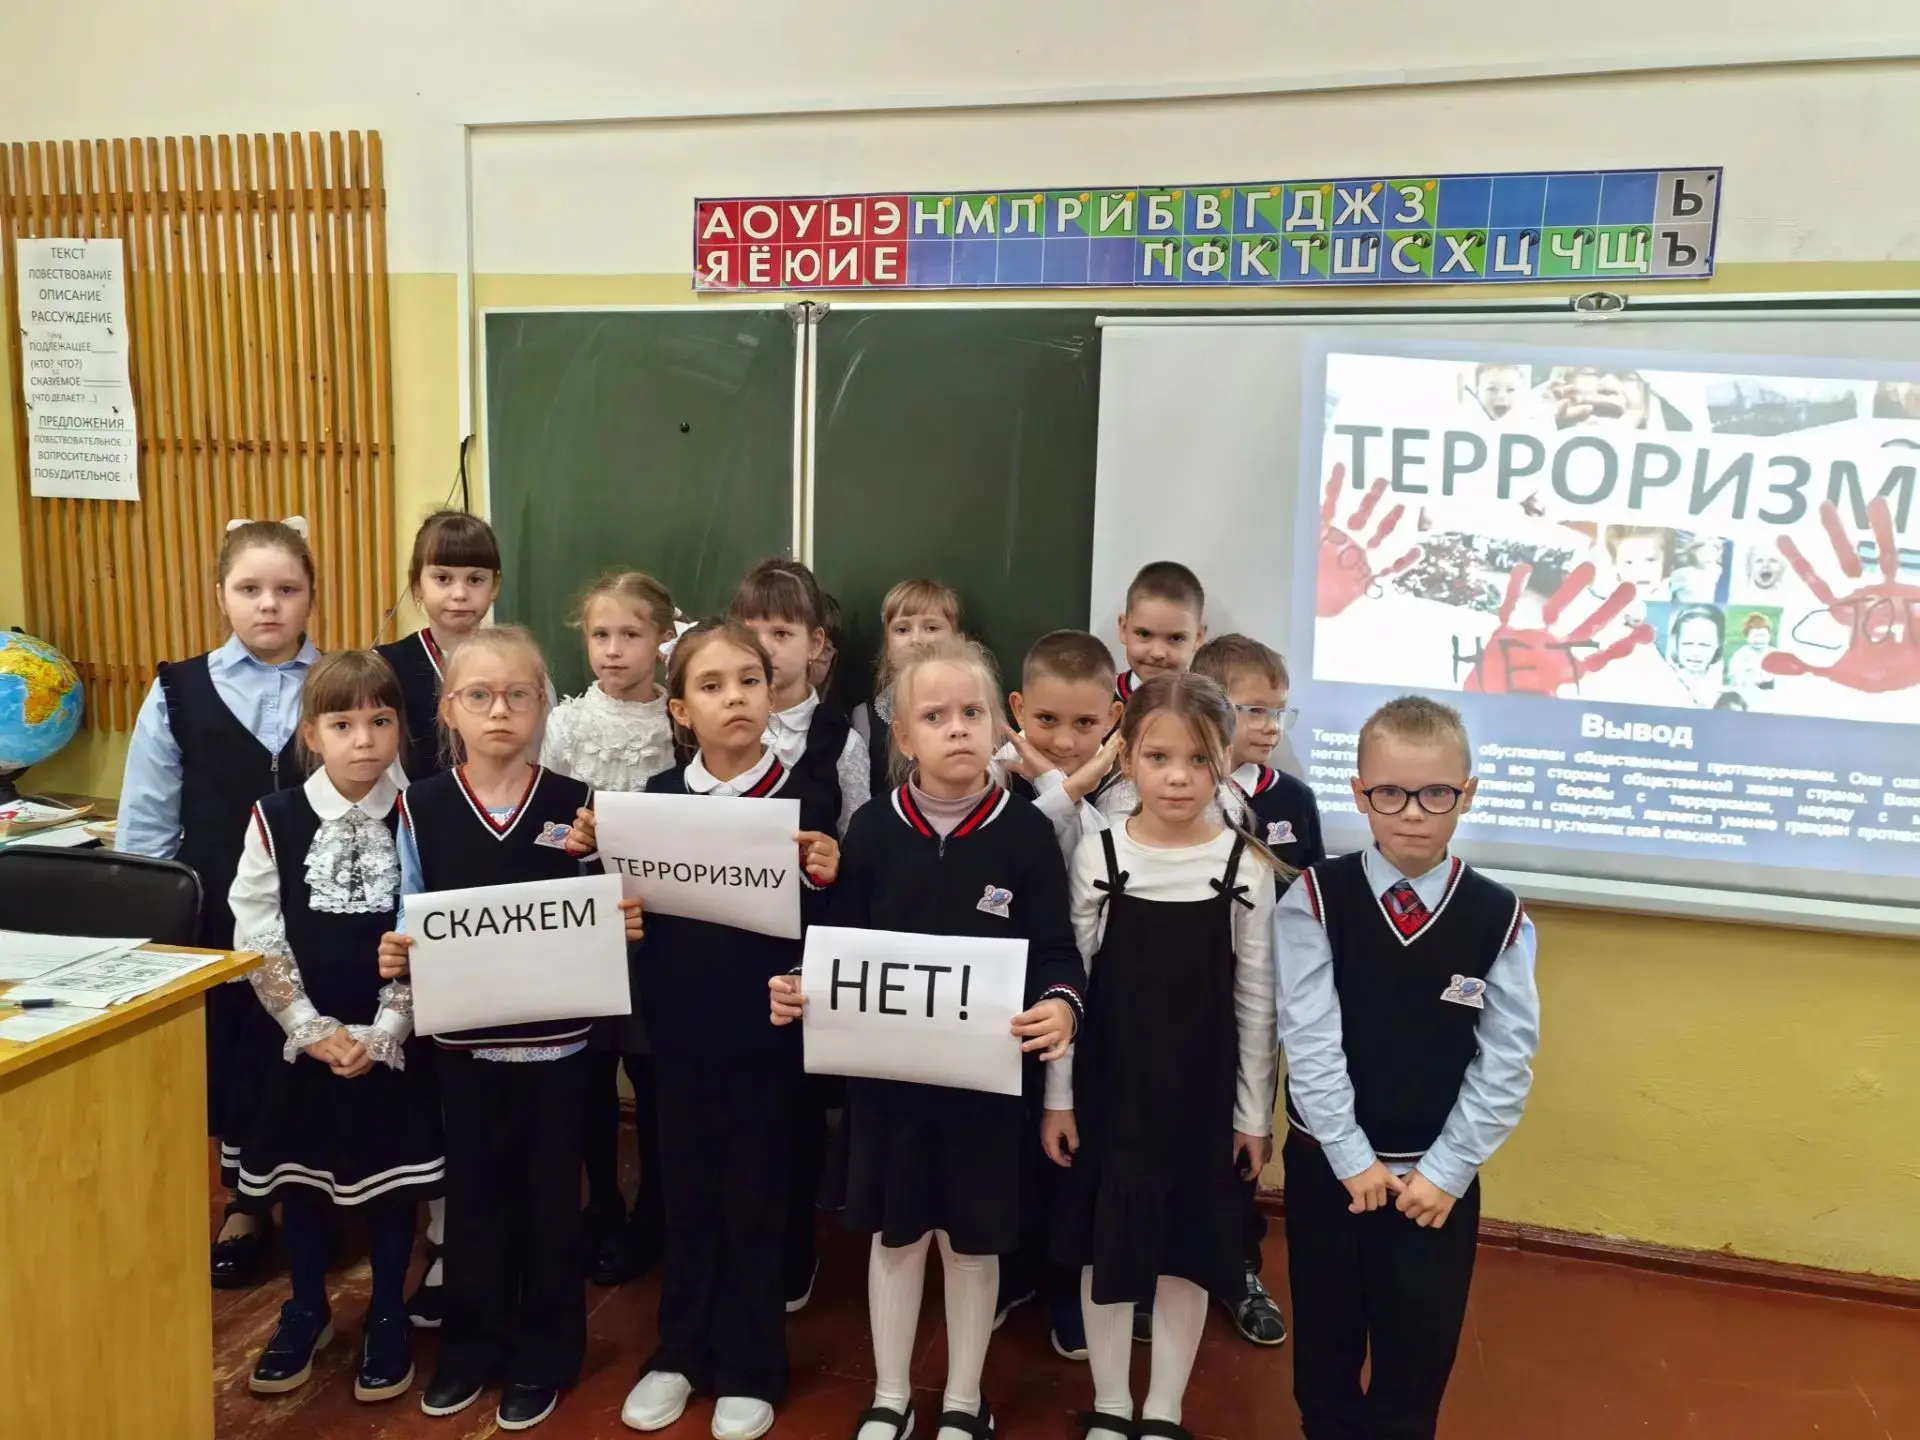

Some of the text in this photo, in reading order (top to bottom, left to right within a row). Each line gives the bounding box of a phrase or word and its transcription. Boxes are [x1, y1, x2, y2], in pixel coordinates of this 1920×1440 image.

[51, 247, 86, 259] ТЕКСТ
[29, 268, 112, 280] ПОВЕСТВОВАНИЕ
[39, 289, 102, 301] ОПИСАНИЕ
[31, 310, 112, 324] РАССУЖДЕНИЕ
[30, 377, 81, 386] СКАЗУЕМОЕ
[39, 416, 124, 429] ПРЕДЛОЖЕНИЯ
[38, 451, 120, 463] ВОПРОСИТЕЛЬНОЕ
[34, 468, 121, 482] ПОБУДИТЕЛЬНОЕ
[1451, 636, 1599, 695] НЕТ
[1581, 713, 1694, 749] Вывод
[612, 857, 785, 888] ТЕРРОРИЗМУ
[424, 898, 594, 940] СКАЖЕМ
[831, 959, 970, 1020] НЕТ!
